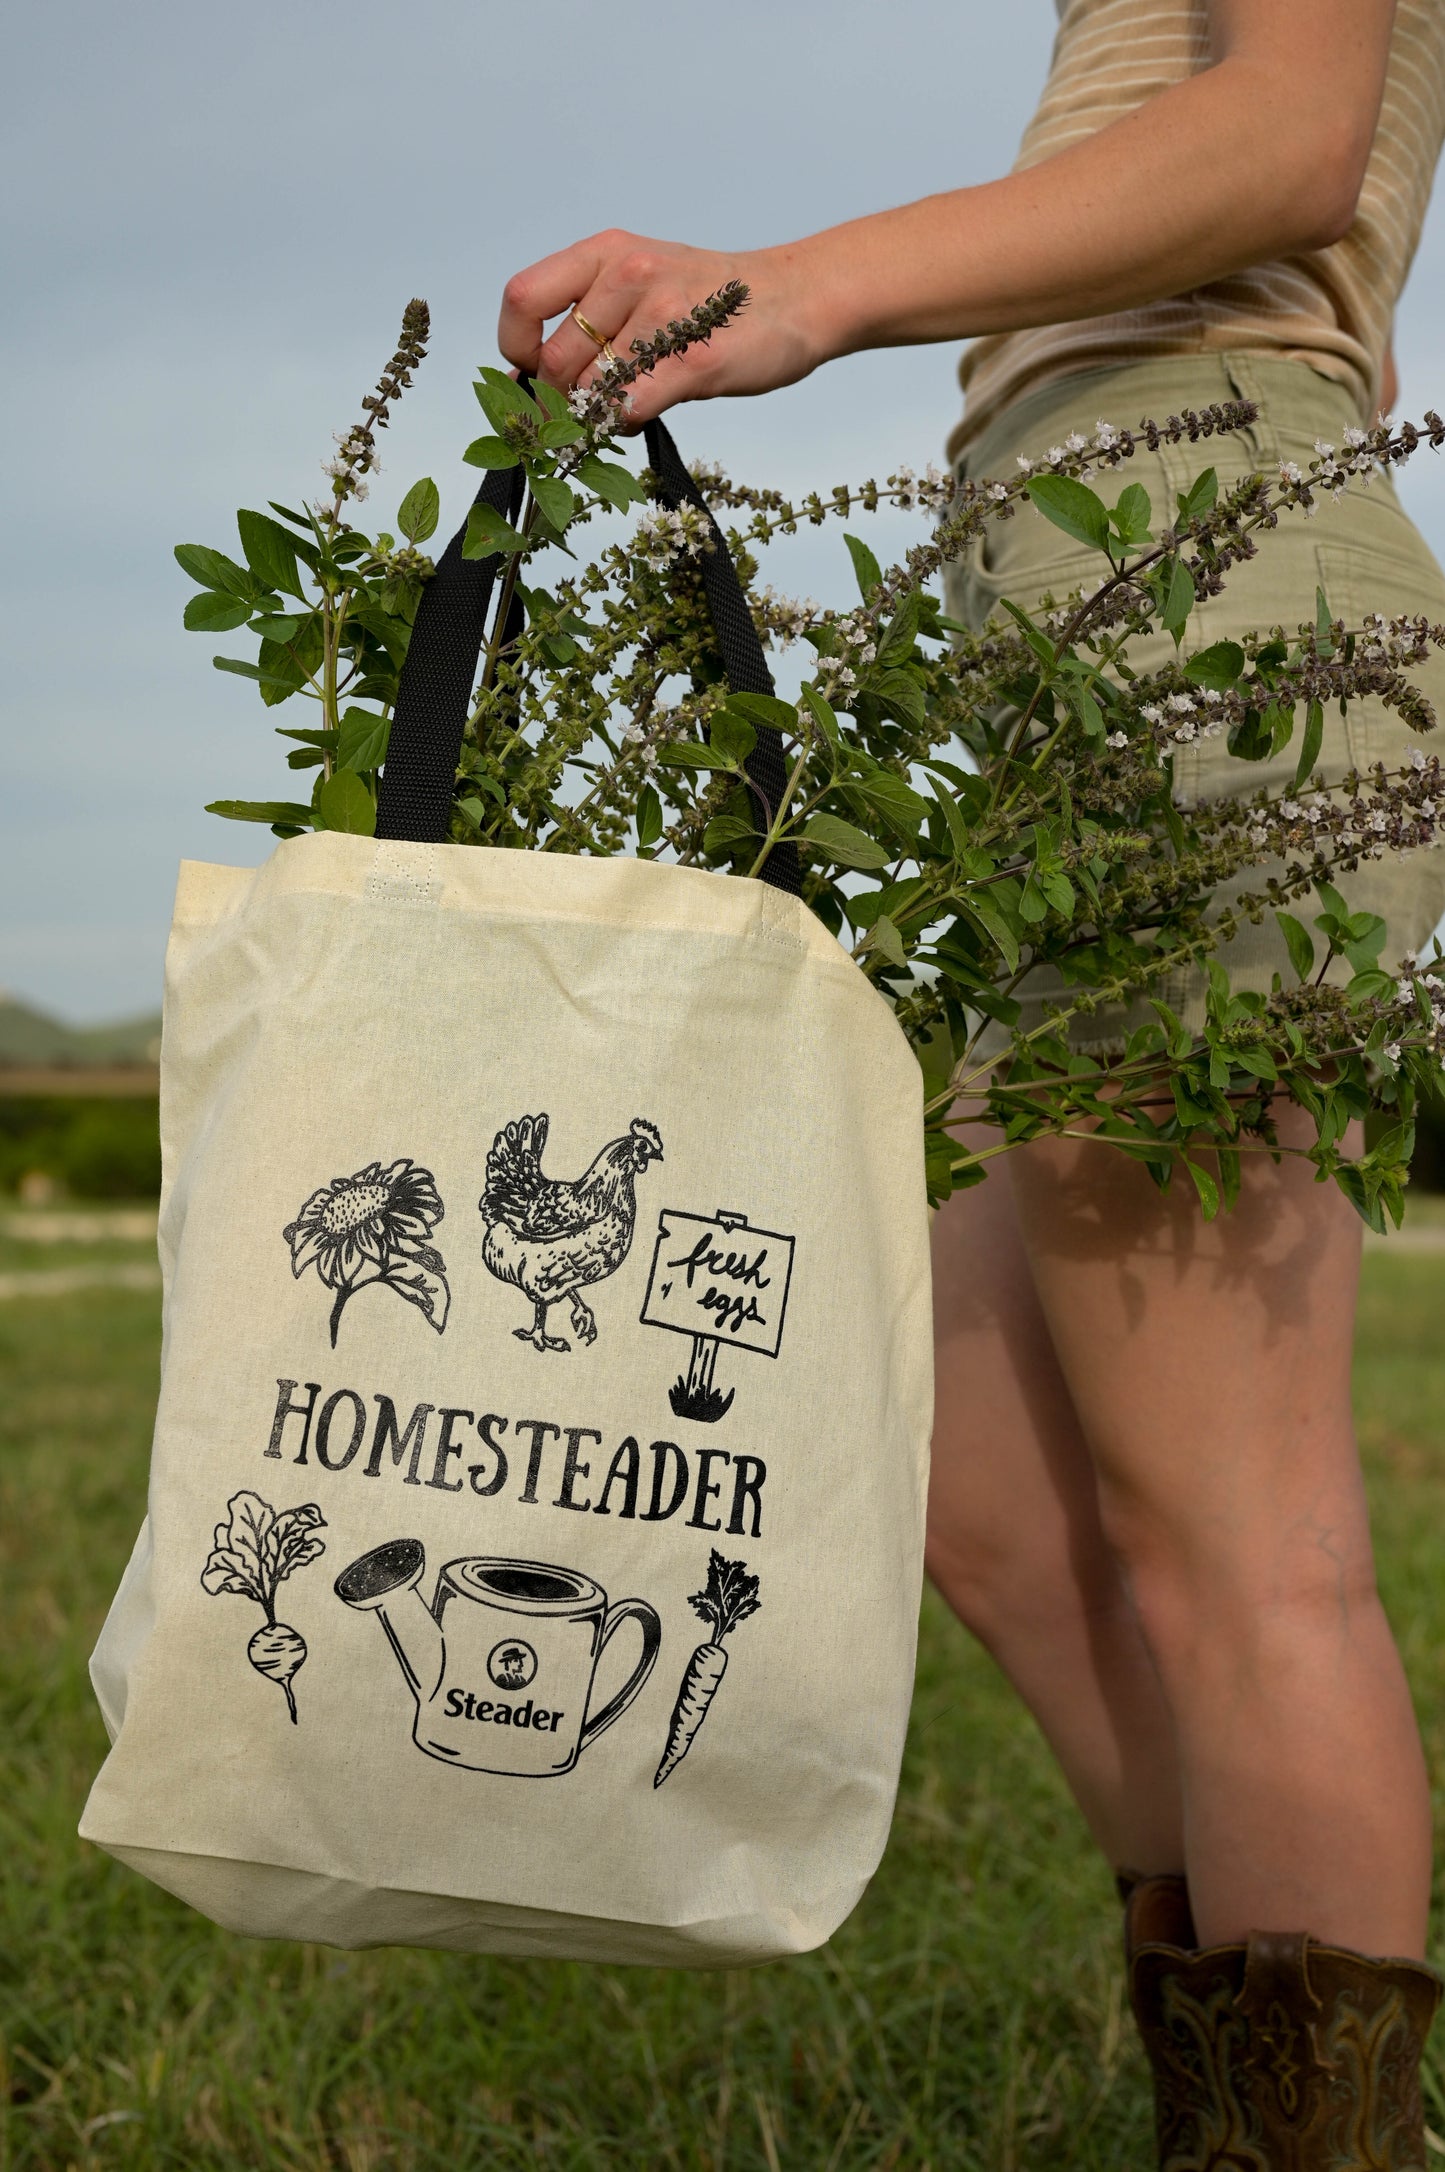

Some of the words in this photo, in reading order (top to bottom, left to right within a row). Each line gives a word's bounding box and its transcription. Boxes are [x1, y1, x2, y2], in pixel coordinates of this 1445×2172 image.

[667, 1232, 771, 1289] fresh
[696, 1286, 766, 1333] eggs
[263, 1378, 768, 1538] HOMESTEADER
[443, 1688, 565, 1732] Steader
